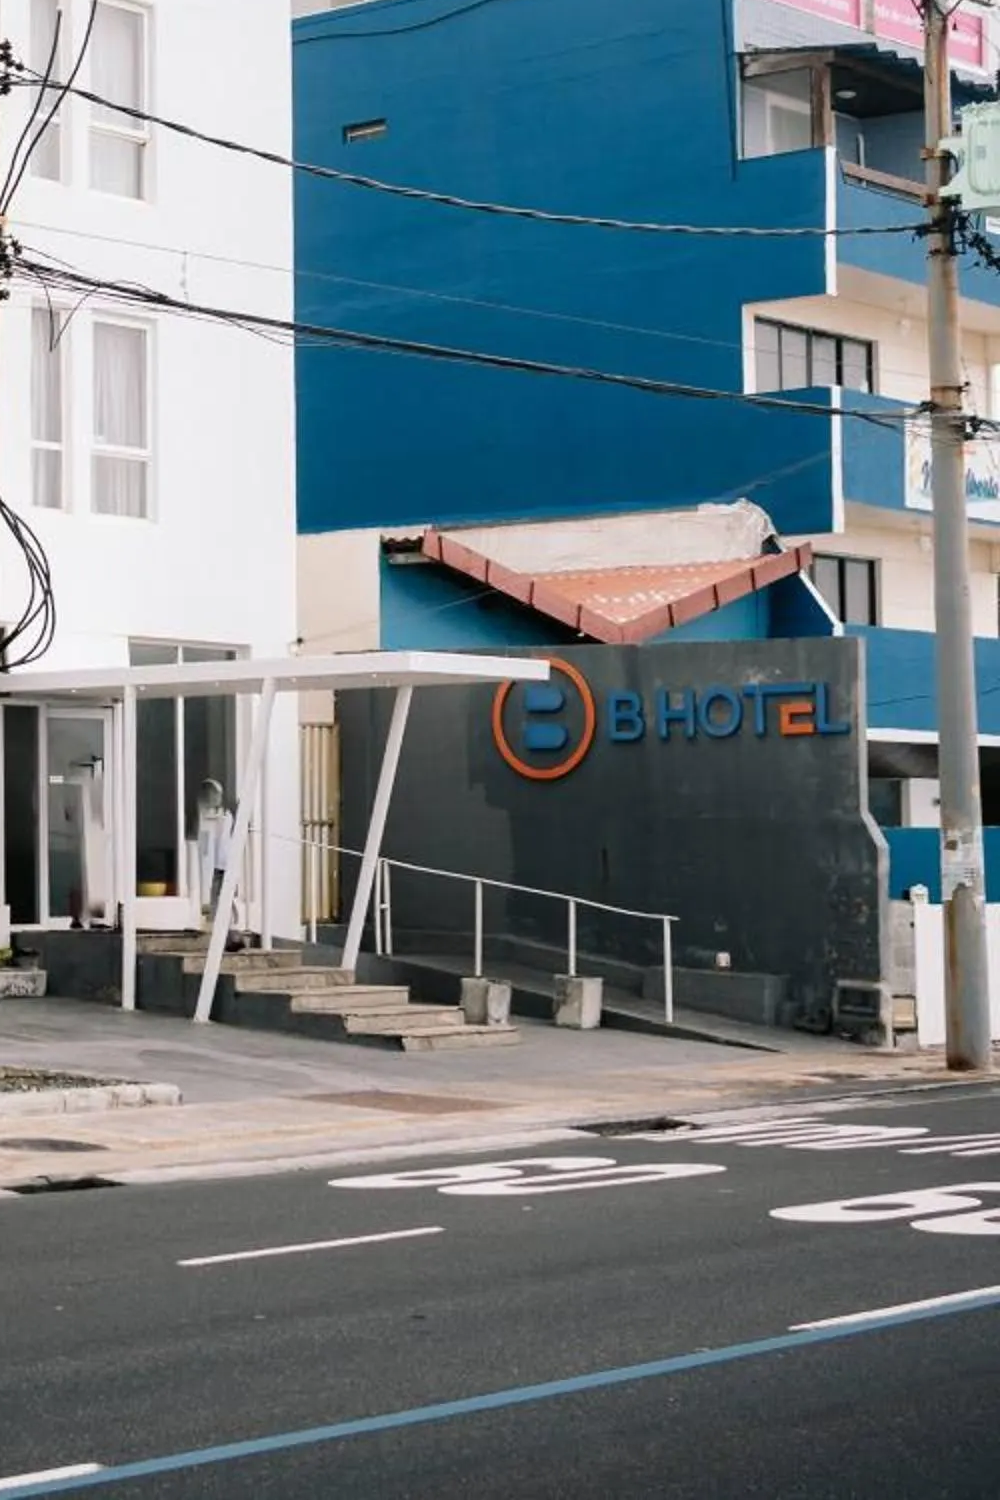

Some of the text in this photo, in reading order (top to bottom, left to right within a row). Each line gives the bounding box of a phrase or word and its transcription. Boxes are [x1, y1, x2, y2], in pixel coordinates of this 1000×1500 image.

[606, 682, 852, 743] B HOTEL
[327, 1156, 728, 1196] 60
